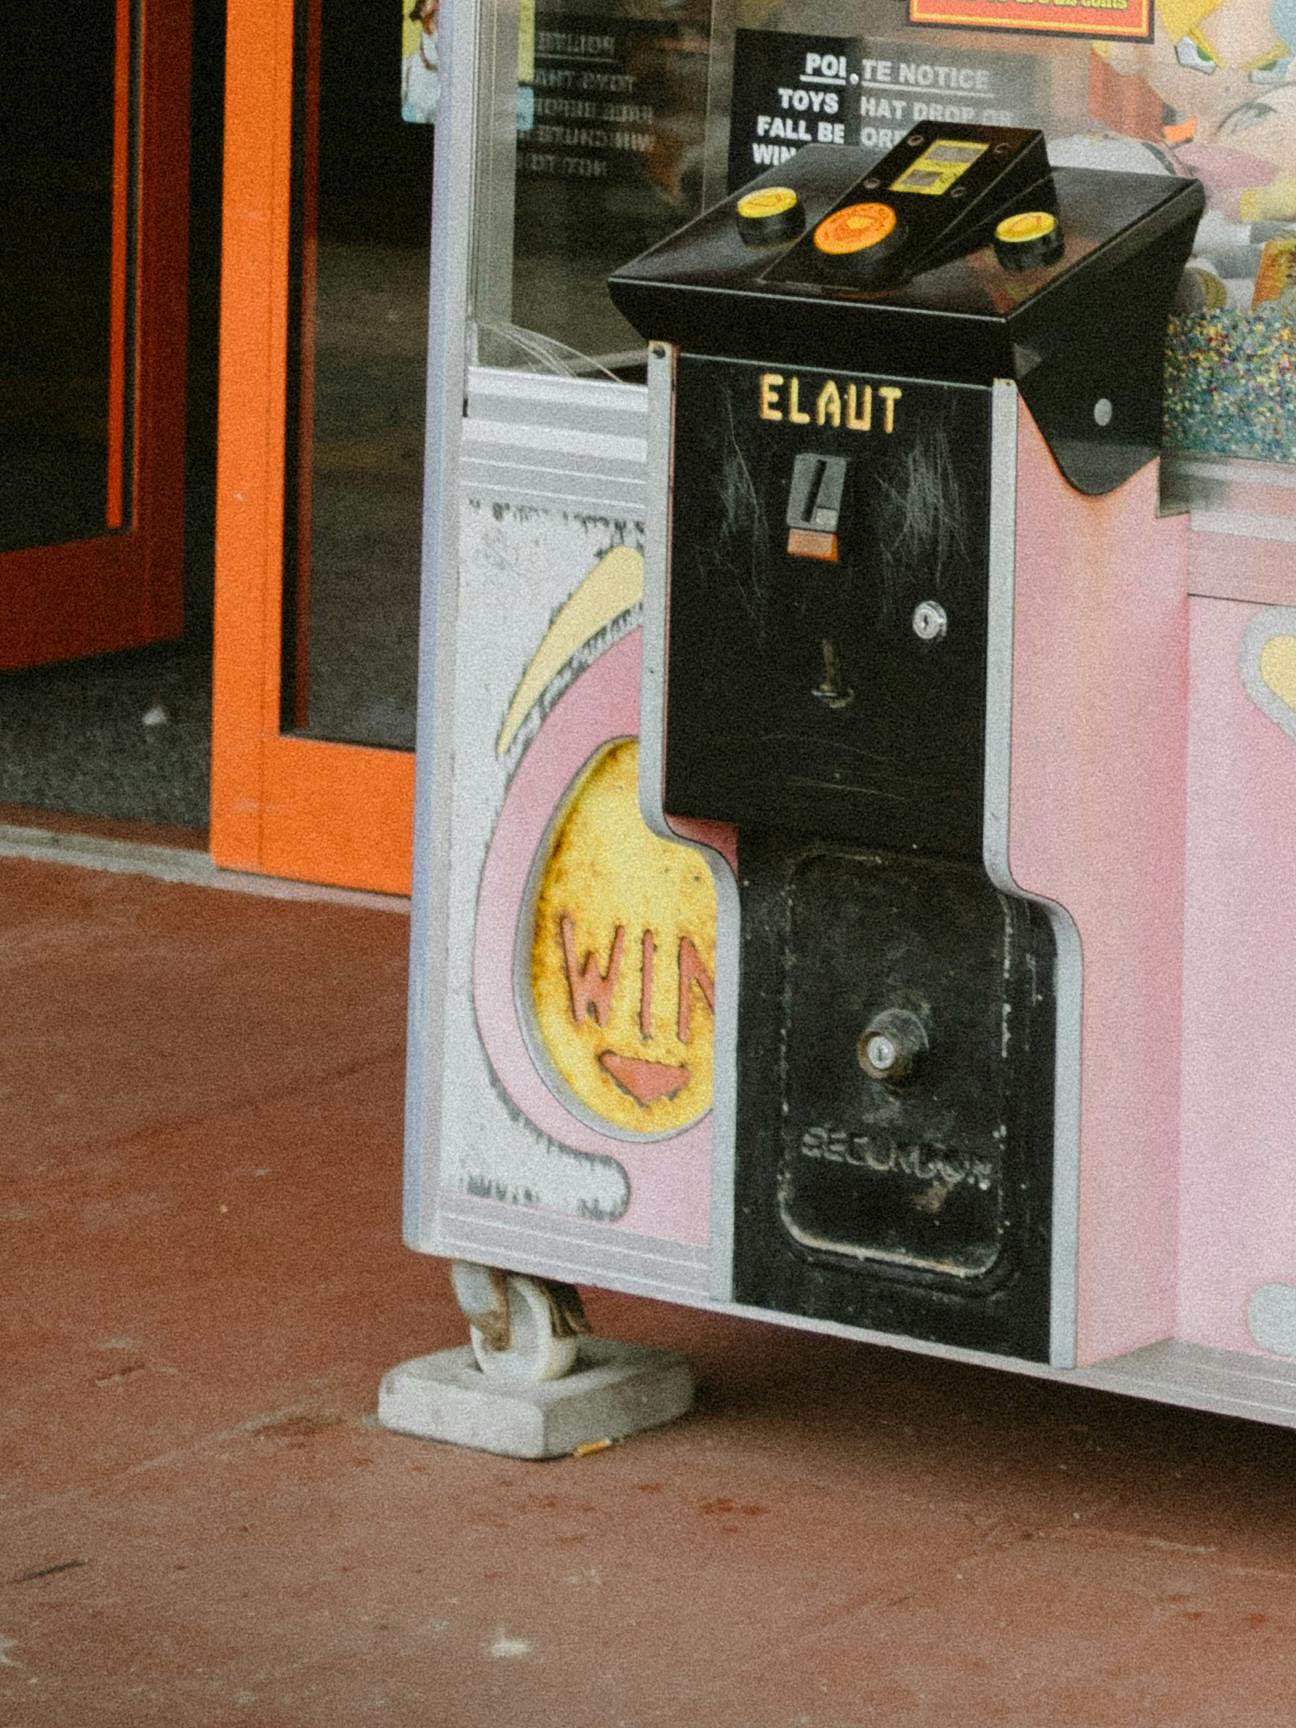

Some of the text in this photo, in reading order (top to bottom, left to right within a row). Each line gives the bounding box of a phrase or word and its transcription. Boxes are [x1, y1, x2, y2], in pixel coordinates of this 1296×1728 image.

[899, 62, 991, 90] NOTICE
[778, 88, 839, 115] TOYS
[860, 95, 907, 120] HAT
[756, 115, 812, 143] FALL
[759, 372, 903, 434] ELAUT
[560, 910, 715, 1045] WIN
